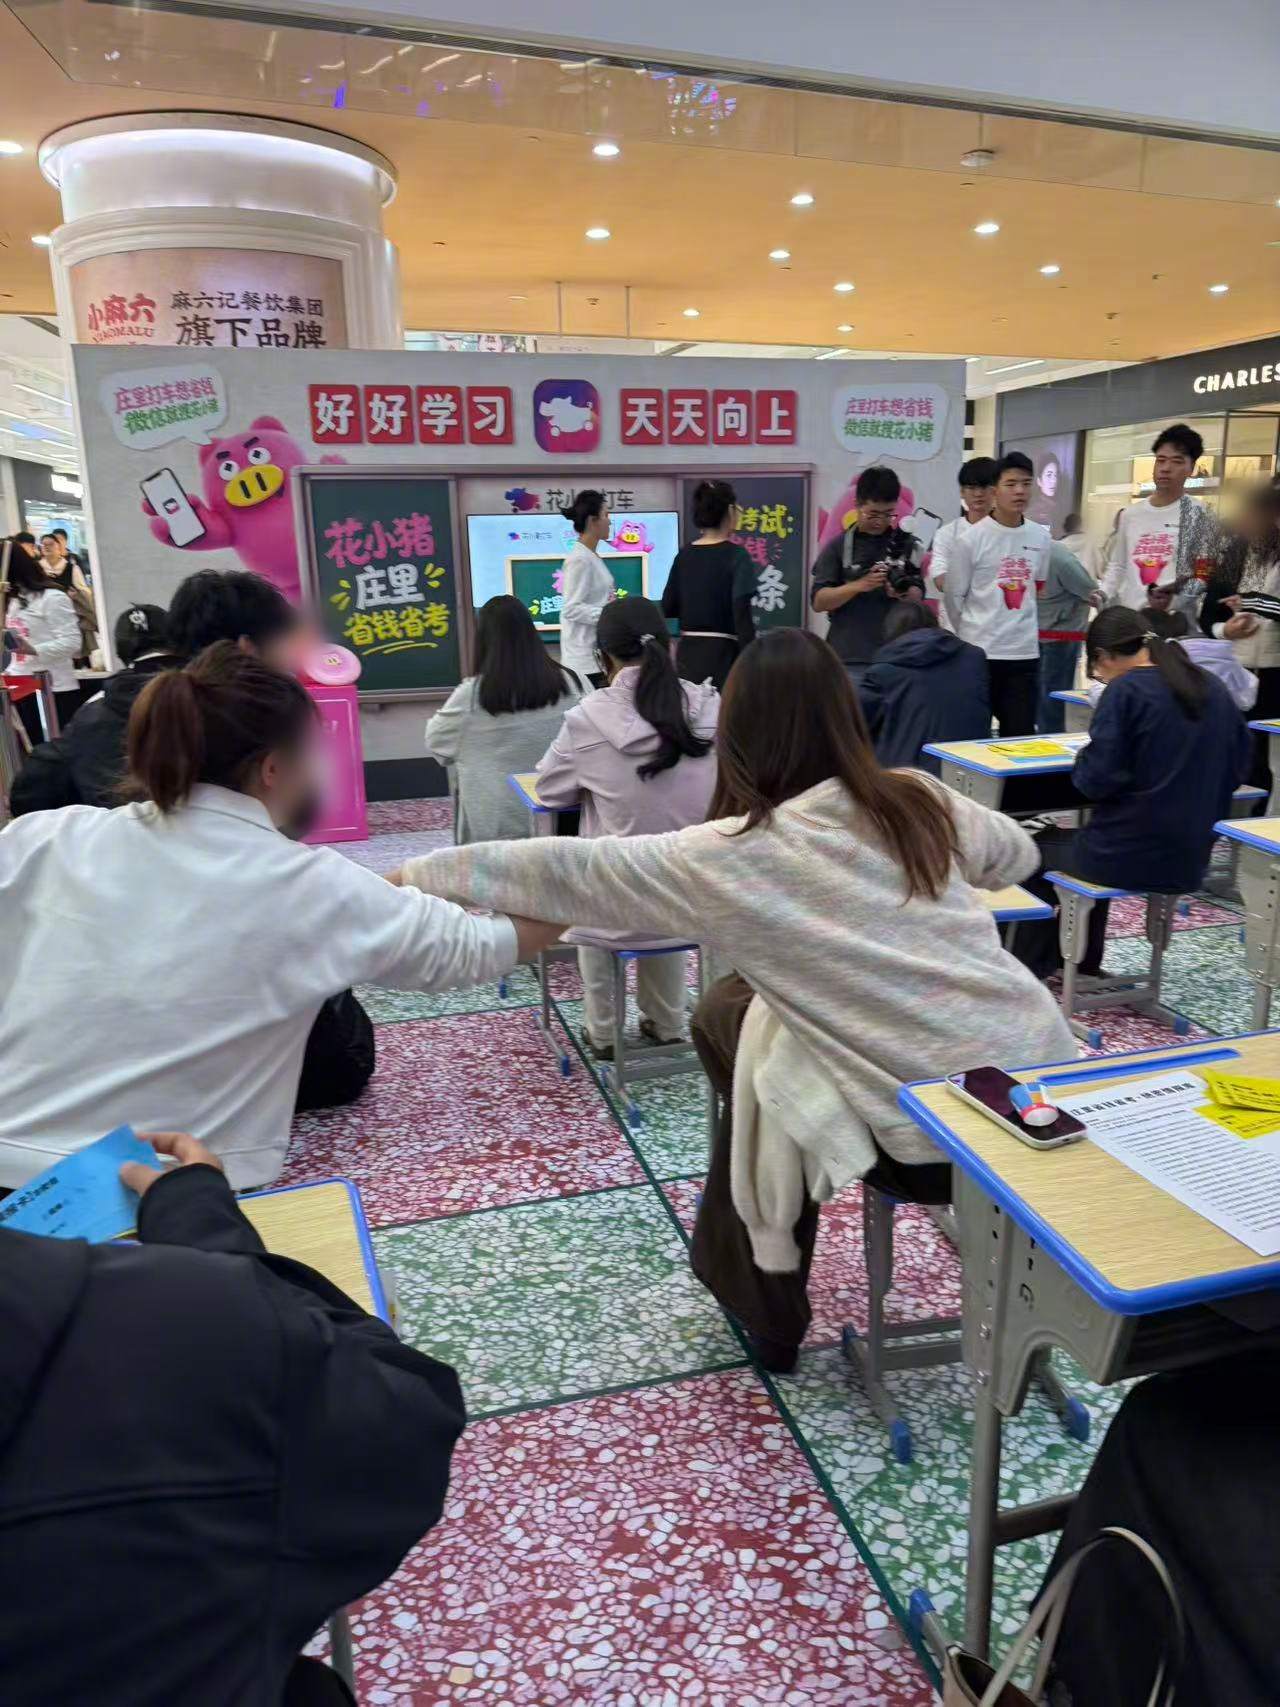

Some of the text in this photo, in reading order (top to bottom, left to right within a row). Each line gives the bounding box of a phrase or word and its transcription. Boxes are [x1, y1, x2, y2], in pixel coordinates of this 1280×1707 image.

[88, 293, 156, 332] 小麻六
[171, 290, 323, 317] 麻六记餐饮集团
[175, 315, 327, 349] 旗下品牌
[315, 393, 506, 437] 好好学习
[625, 398, 792, 438] 天天向上
[845, 397, 935, 418] 庄里打车想省钱
[546, 489, 635, 511] 花小打车
[324, 512, 435, 569] 花小猪
[355, 564, 426, 610] 庄里
[342, 602, 449, 646] 省钱省考
